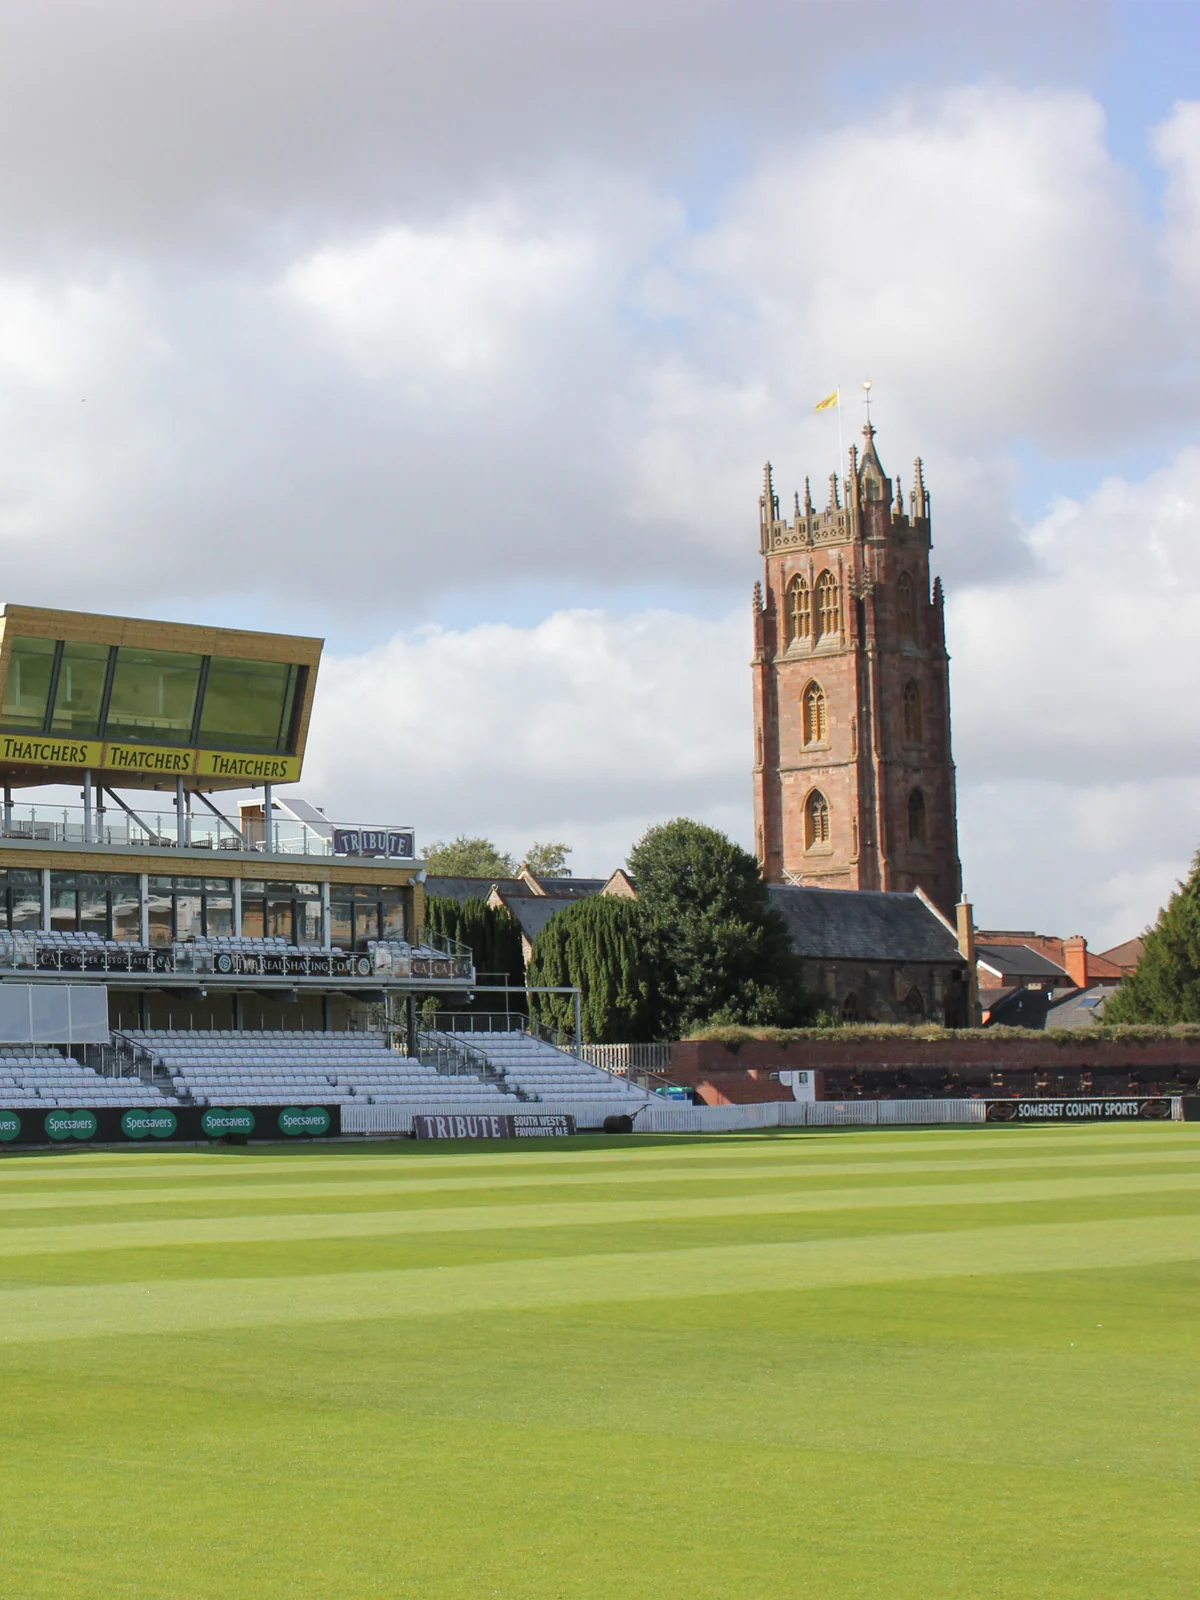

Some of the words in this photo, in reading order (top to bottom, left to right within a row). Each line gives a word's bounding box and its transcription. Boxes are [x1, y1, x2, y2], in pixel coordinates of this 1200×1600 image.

[3, 738, 88, 762] THATCHERS
[110, 747, 190, 770] THATCHERS
[211, 755, 287, 777] THATCHERS
[340, 832, 406, 855] TRIBUTE
[40, 953, 57, 965] CA
[64, 956, 98, 964] COOPER
[261, 959, 284, 970] REAL
[285, 960, 329, 971] SHAVING
[413, 963, 428, 973] CA
[434, 963, 448, 974] CA
[454, 963, 468, 974] CA
[1018, 1103, 1064, 1117] SOMERSET
[1066, 1103, 1103, 1116] COUNTY
[1104, 1102, 1138, 1116] SPORTS
[49, 1117, 92, 1132] Specsavers
[126, 1116, 172, 1131] Specsavers
[206, 1115, 250, 1129] Specsavers
[283, 1113, 325, 1128] Specsavers
[423, 1115, 501, 1139] TRIBUTE
[513, 1115, 538, 1127] SOUTH
[539, 1115, 567, 1127] WEST'S
[514, 1126, 554, 1138] FAVOURITE
[555, 1126, 569, 1137] ALE
